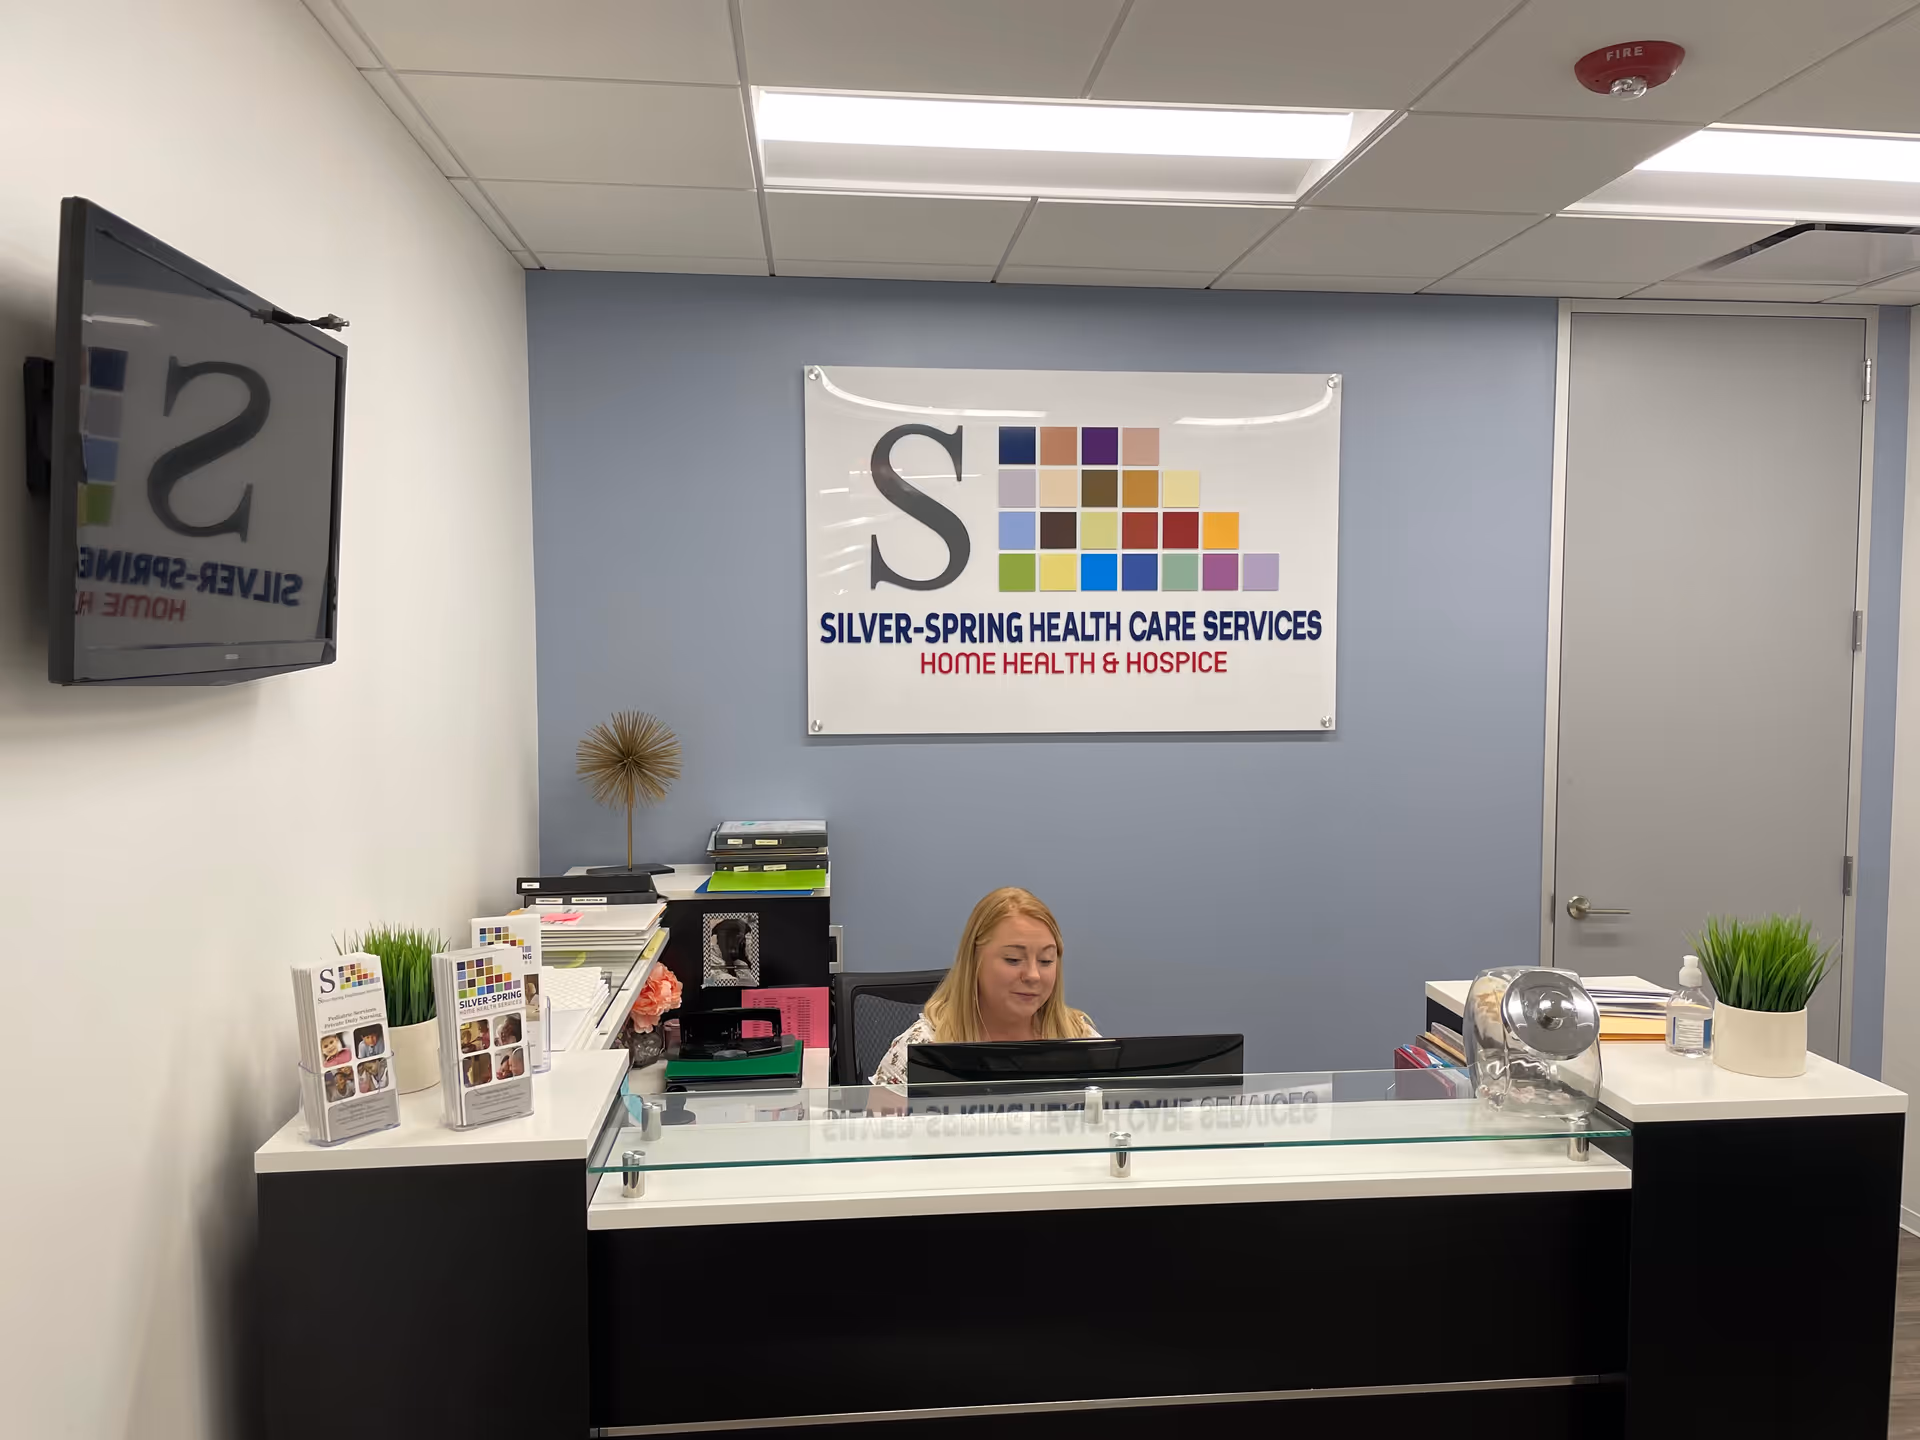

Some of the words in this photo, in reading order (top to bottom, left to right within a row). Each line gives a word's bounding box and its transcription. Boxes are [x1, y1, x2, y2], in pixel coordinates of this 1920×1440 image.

[1606, 46, 1643, 61] FIRE
[870, 423, 971, 591] S
[820, 612, 1023, 644] SILVER-SPRING
[1029, 611, 1121, 642] HEALTH
[1129, 611, 1196, 641] CARE
[1203, 610, 1322, 641] SERVICES
[920, 652, 996, 674] HOME
[1003, 652, 1095, 674] HEALTH
[1102, 652, 1120, 674] &
[1126, 651, 1228, 674] HOSPICE
[319, 968, 336, 994] S
[459, 990, 522, 1009] SILVER-SPRING
[497, 999, 522, 1009] SERVICES
